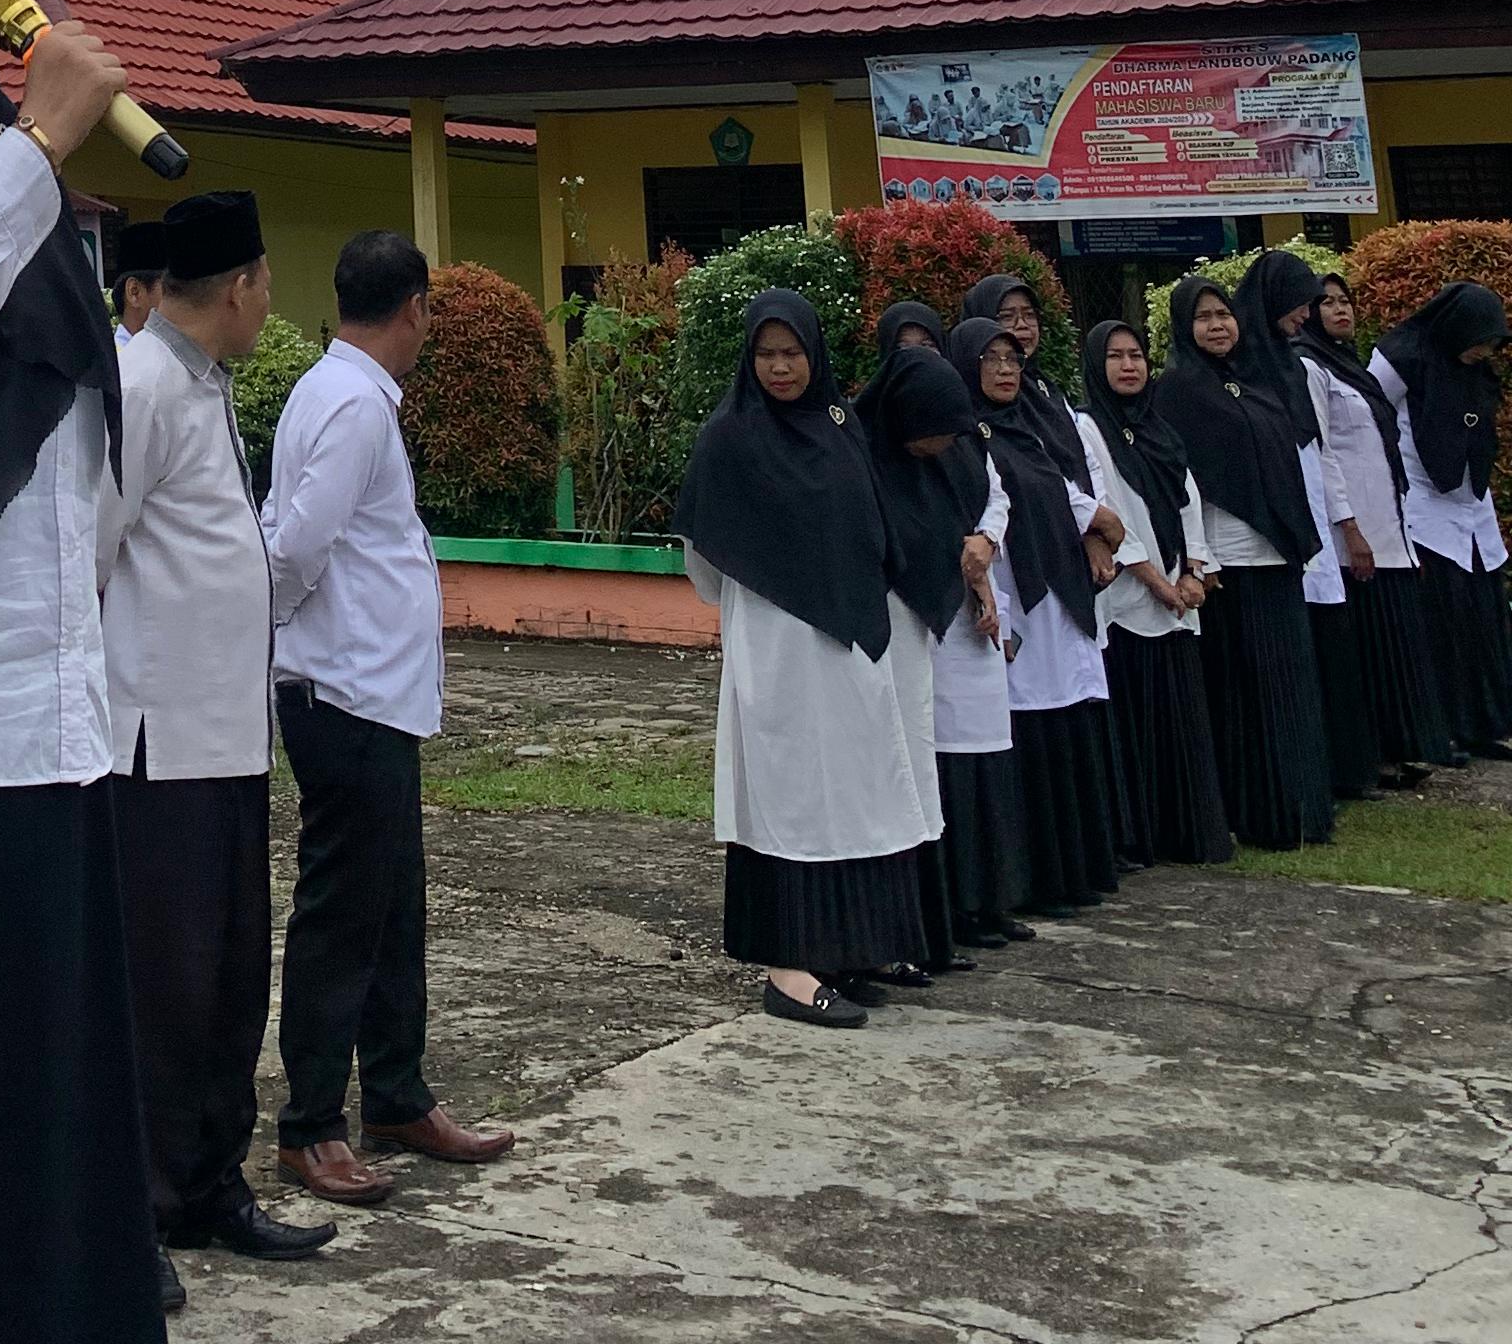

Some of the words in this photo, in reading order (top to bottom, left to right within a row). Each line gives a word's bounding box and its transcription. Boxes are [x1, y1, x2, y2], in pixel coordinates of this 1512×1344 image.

[1113, 61, 1183, 73] DHARMA
[1188, 55, 1282, 69] LANDBOUW
[1288, 51, 1356, 65] PADANG
[1272, 73, 1318, 82] PROGRAM
[1320, 72, 1347, 80] STUDI
[1093, 78, 1193, 96] PENDAFTARAN
[1095, 98, 1182, 115] MAHASISWA
[1186, 96, 1226, 111] BARU
[1097, 118, 1119, 126] TAHUN
